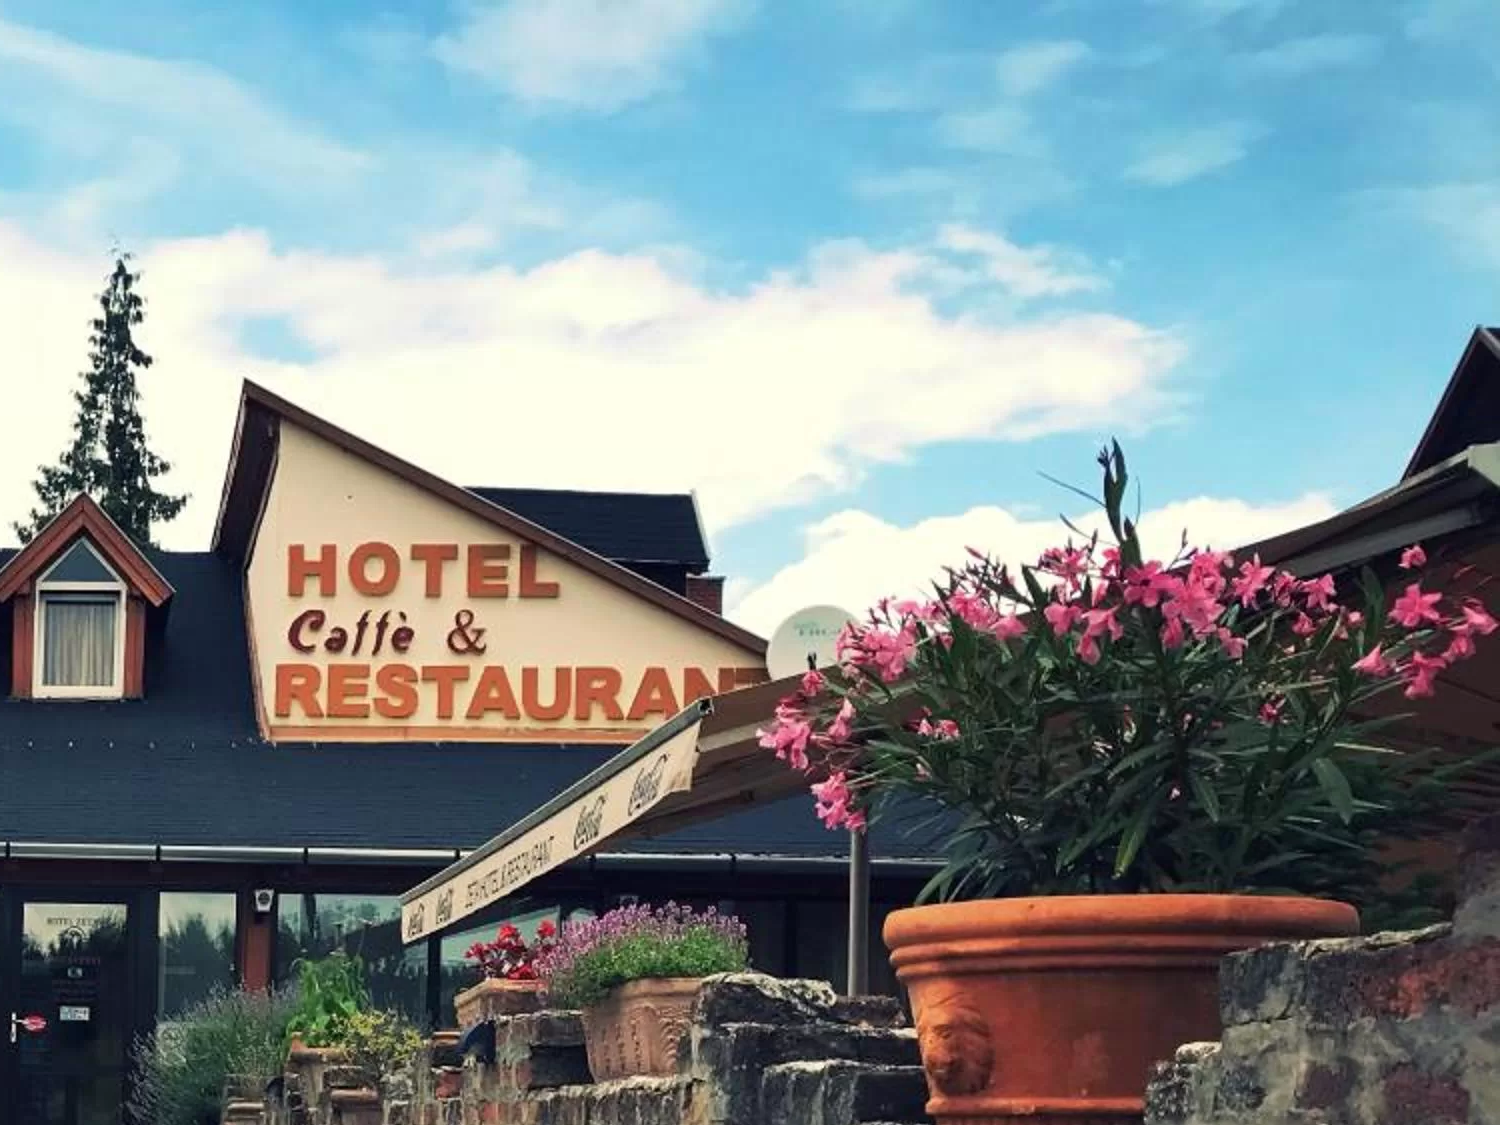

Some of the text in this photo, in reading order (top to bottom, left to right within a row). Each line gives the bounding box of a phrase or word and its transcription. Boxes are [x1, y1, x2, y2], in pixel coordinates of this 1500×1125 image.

[286, 541, 560, 598] HOTEL
[287, 609, 487, 656] Caffè &
